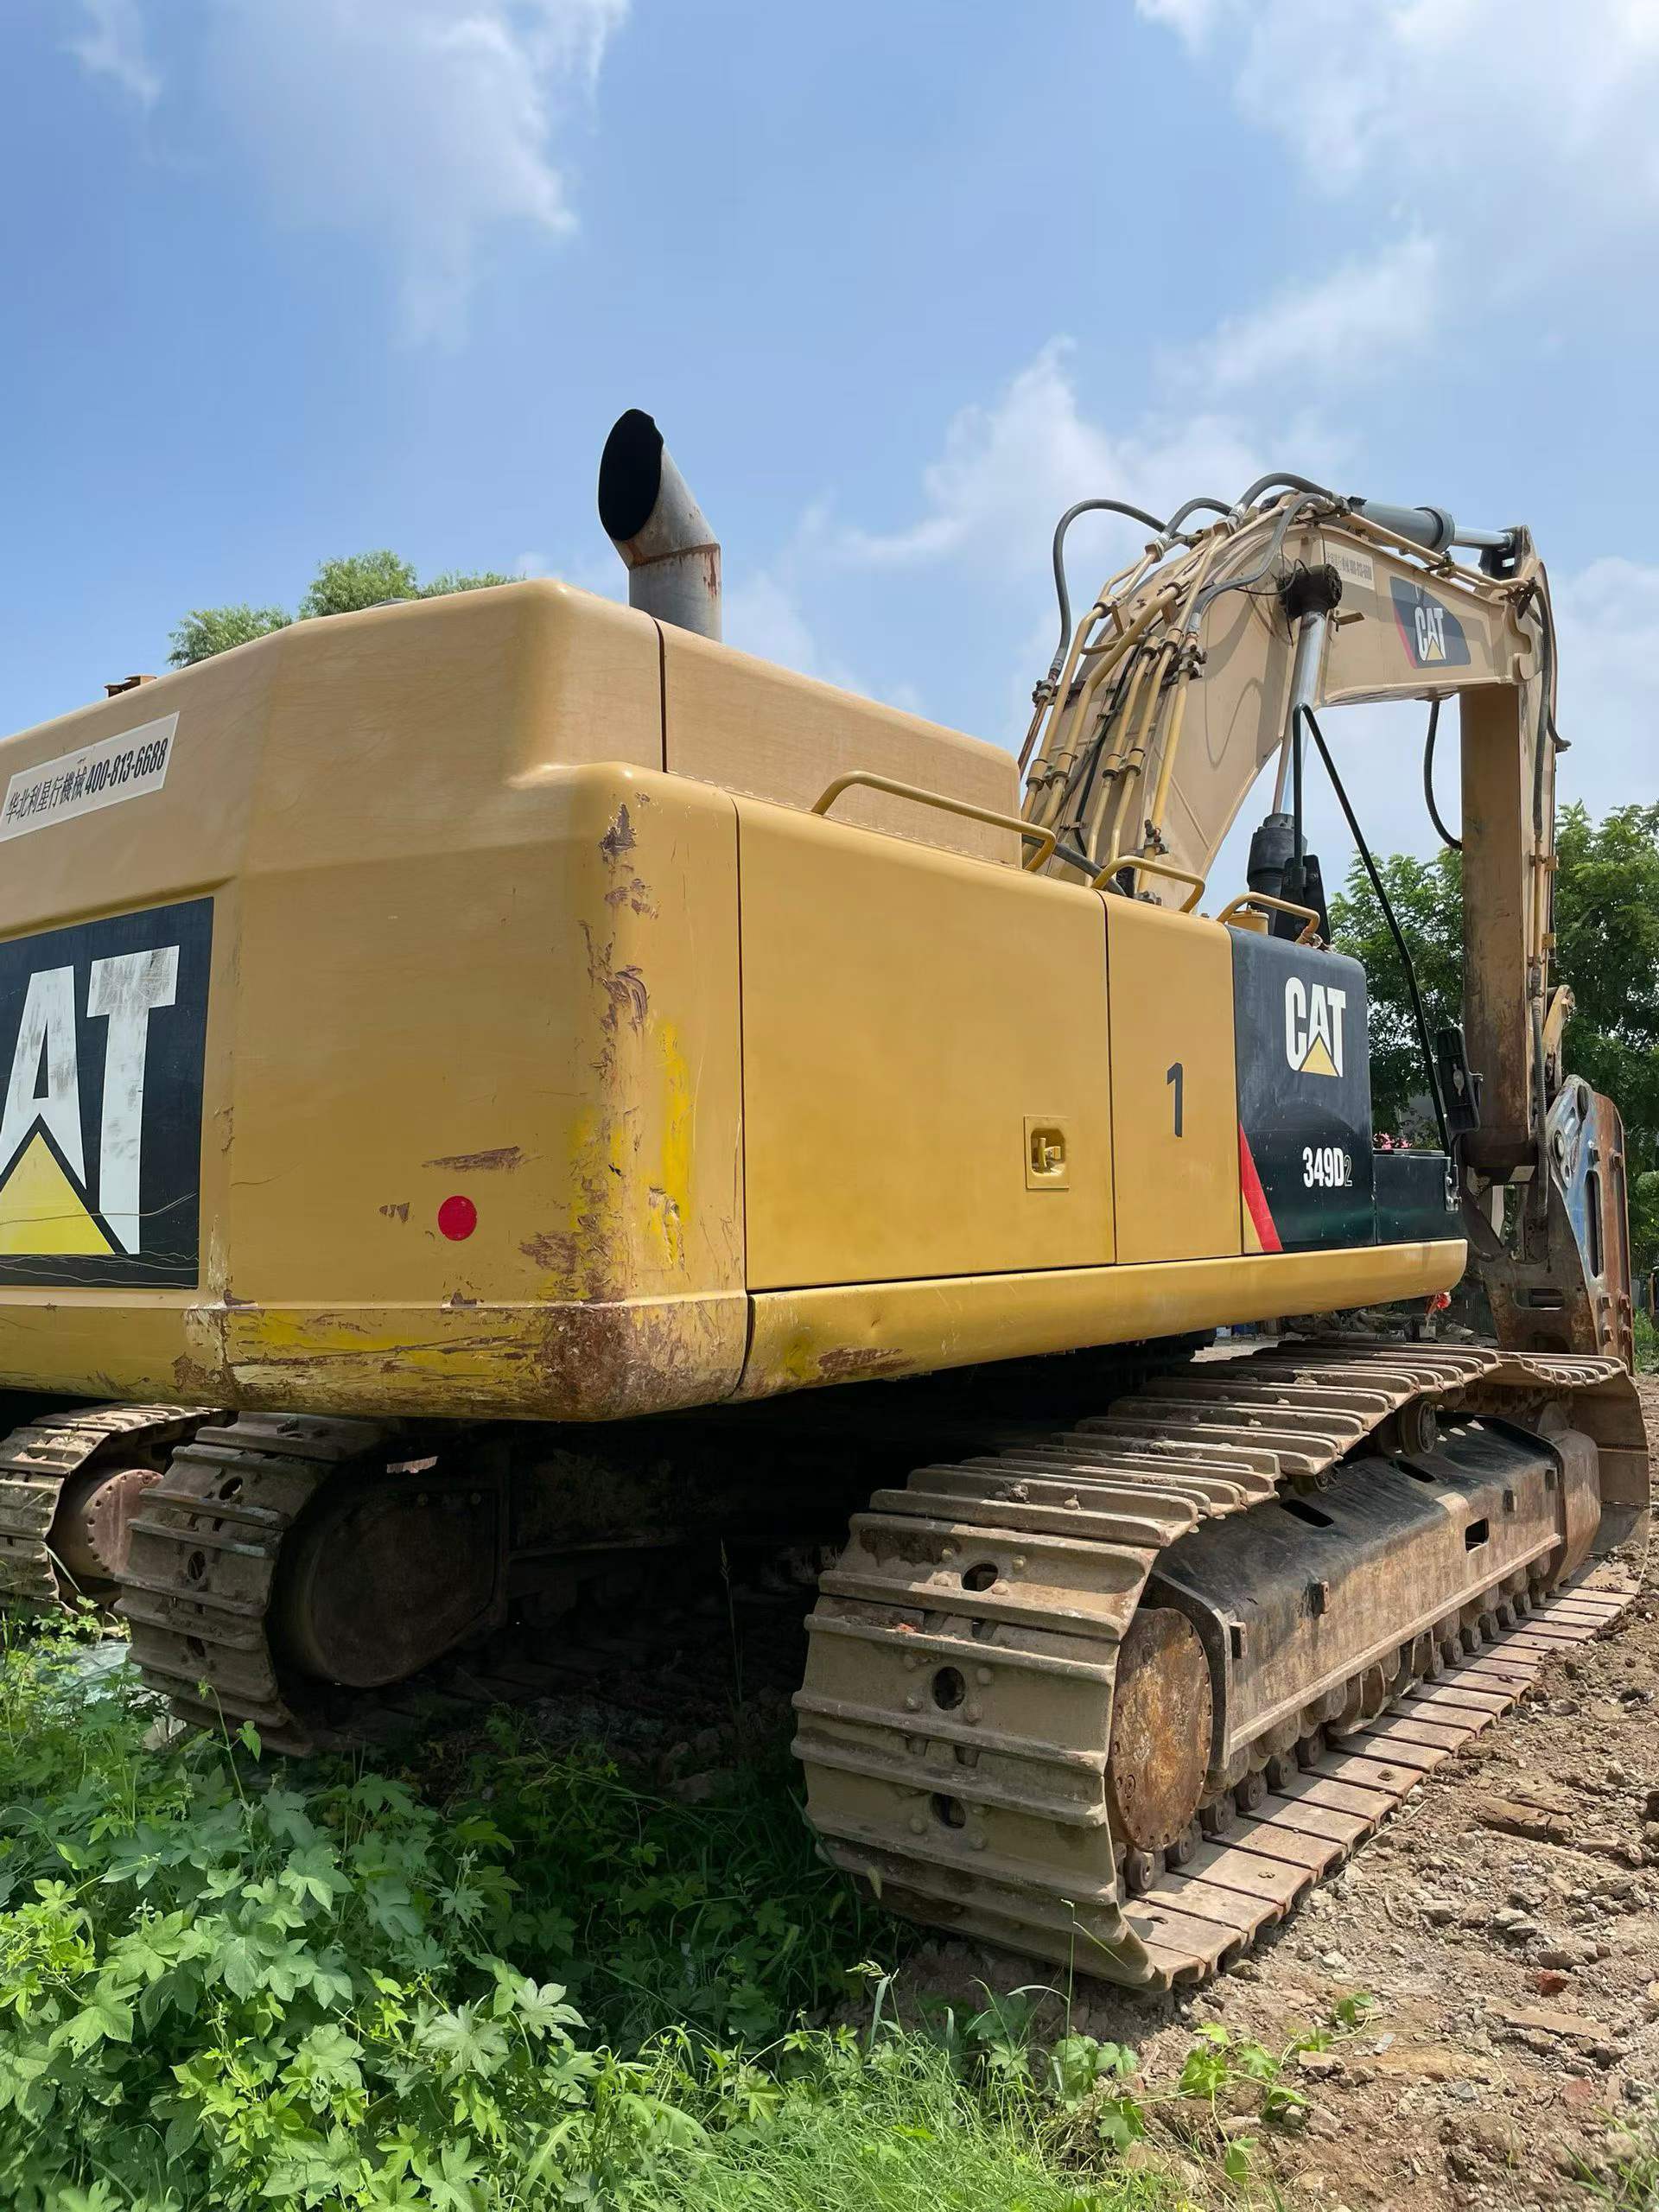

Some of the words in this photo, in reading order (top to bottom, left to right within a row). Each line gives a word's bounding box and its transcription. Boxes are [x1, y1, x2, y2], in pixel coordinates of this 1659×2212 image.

[1414, 607, 1446, 660] CAT
[85, 738, 168, 794] 400-813-6688
[1285, 976, 1346, 1077] CAT
[1166, 1062, 1183, 1137] 1
